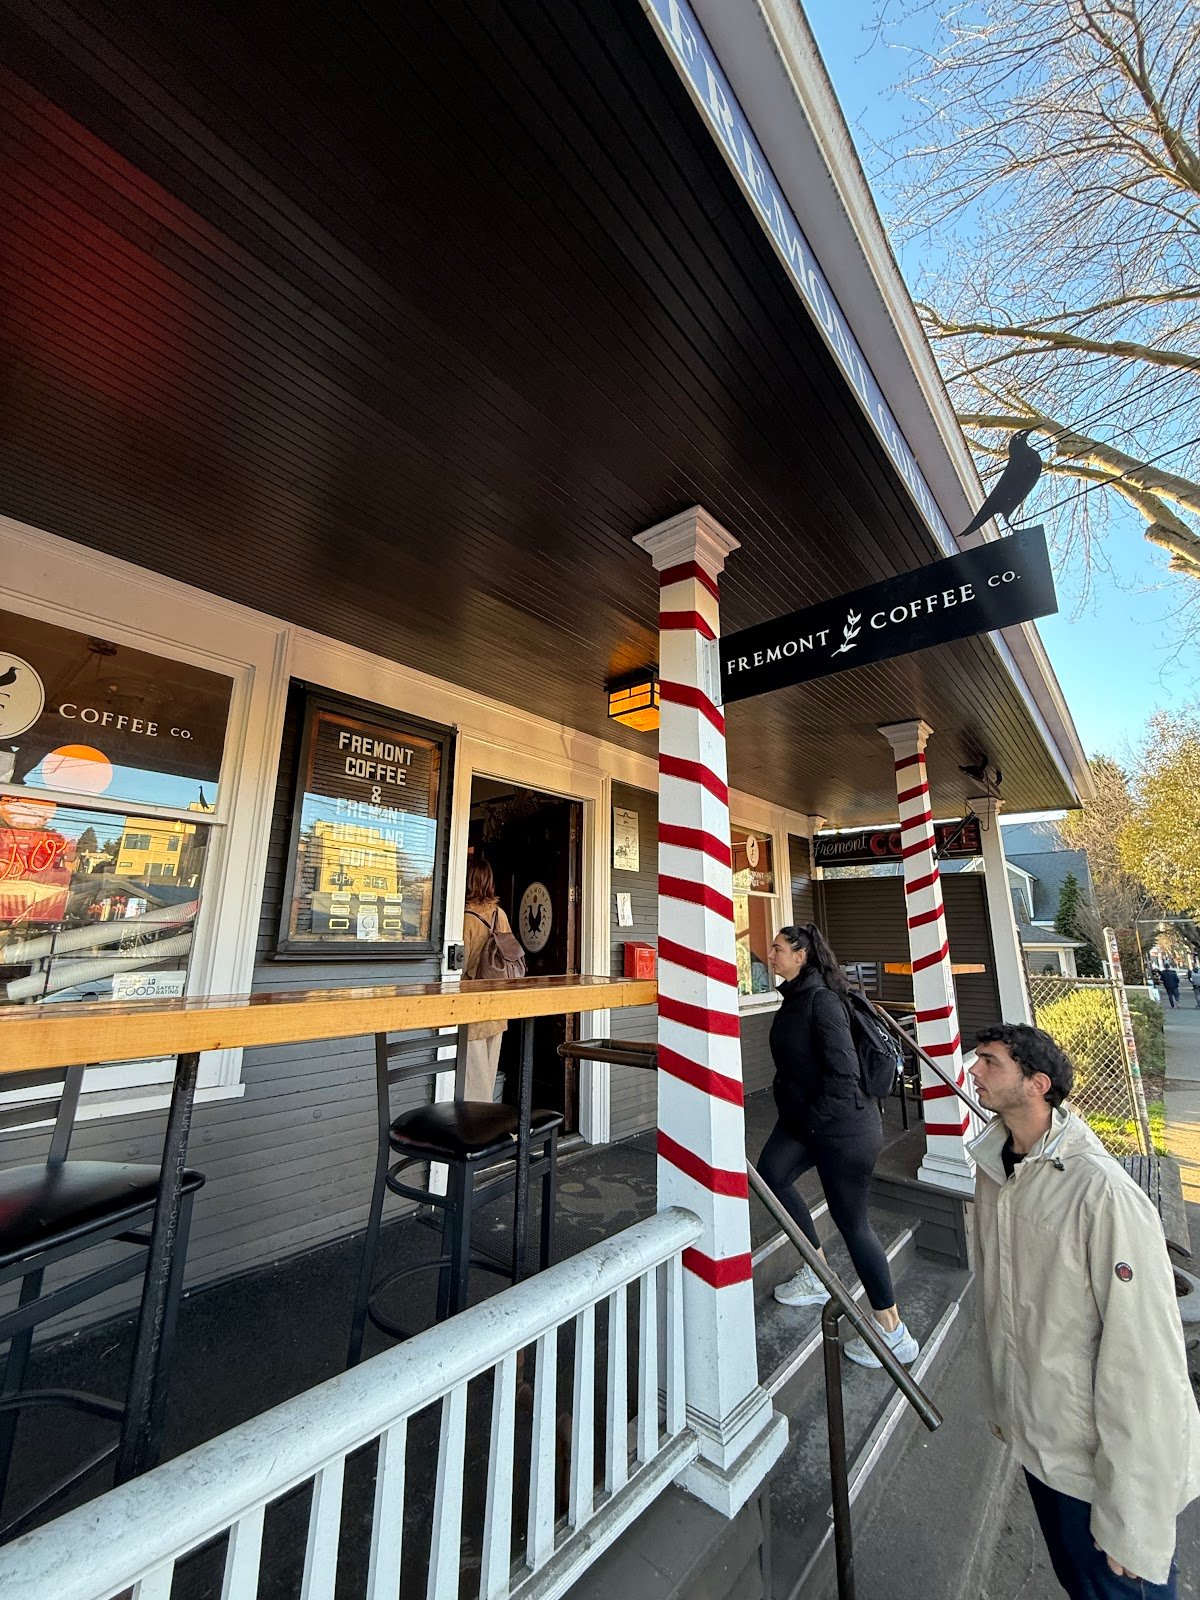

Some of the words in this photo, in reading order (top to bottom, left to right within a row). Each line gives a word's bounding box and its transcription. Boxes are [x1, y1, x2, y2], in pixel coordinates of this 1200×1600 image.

[727, 628, 830, 676] FREMONT
[870, 583, 976, 630] COFFEE
[987, 570, 1021, 588] CO.
[59, 703, 159, 738] COFFEE
[170, 726, 194, 741] CO.
[338, 731, 414, 766] FREMONT
[345, 756, 407, 787] COFFEE
[371, 785, 382, 803] &
[335, 797, 408, 826] FREMONT
[812, 831, 869, 858] Fremont
[870, 823, 978, 856] COEE
[118, 986, 156, 997] FOOD
